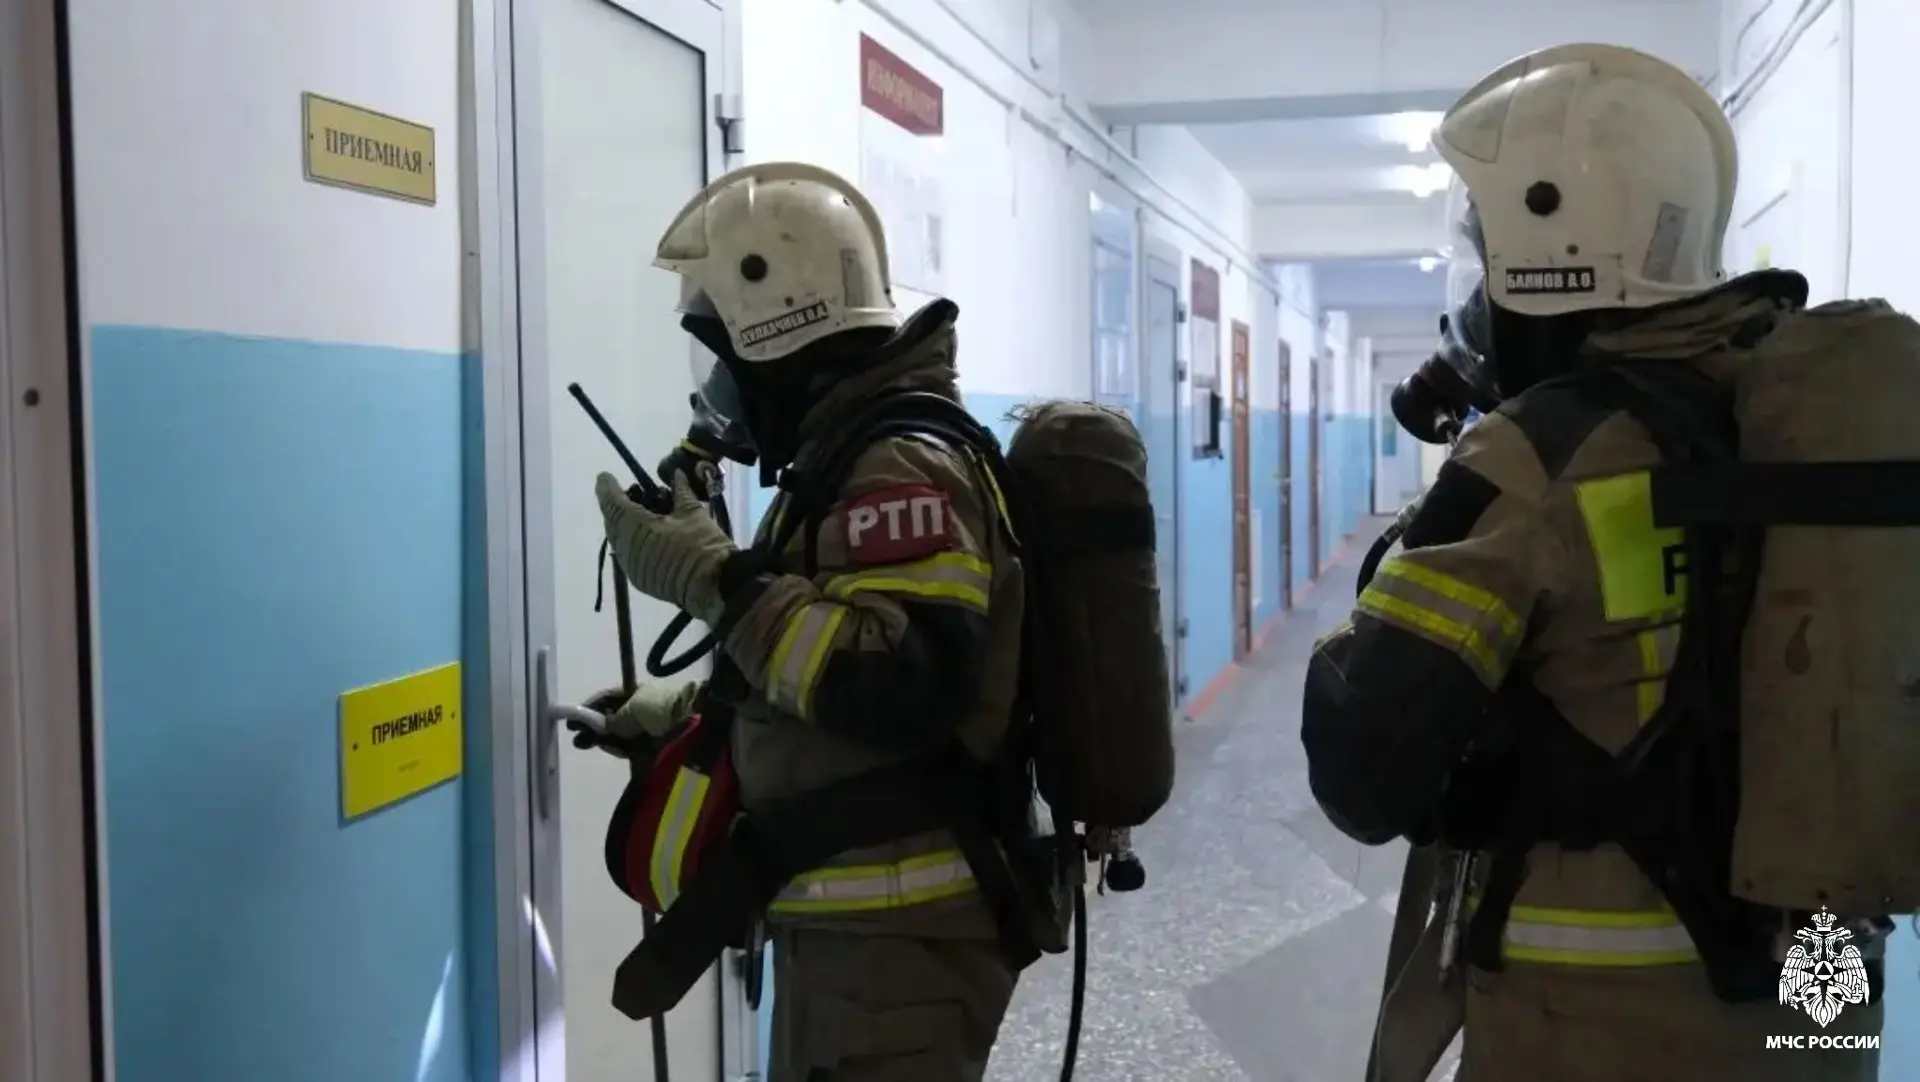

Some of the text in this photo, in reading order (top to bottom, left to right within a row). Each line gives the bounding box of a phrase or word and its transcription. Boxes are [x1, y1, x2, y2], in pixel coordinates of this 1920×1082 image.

[323, 127, 422, 174] ПРИЕМНАЯ
[848, 496, 944, 548] РТП
[372, 705, 443, 745] ПРИЕМНАЯ
